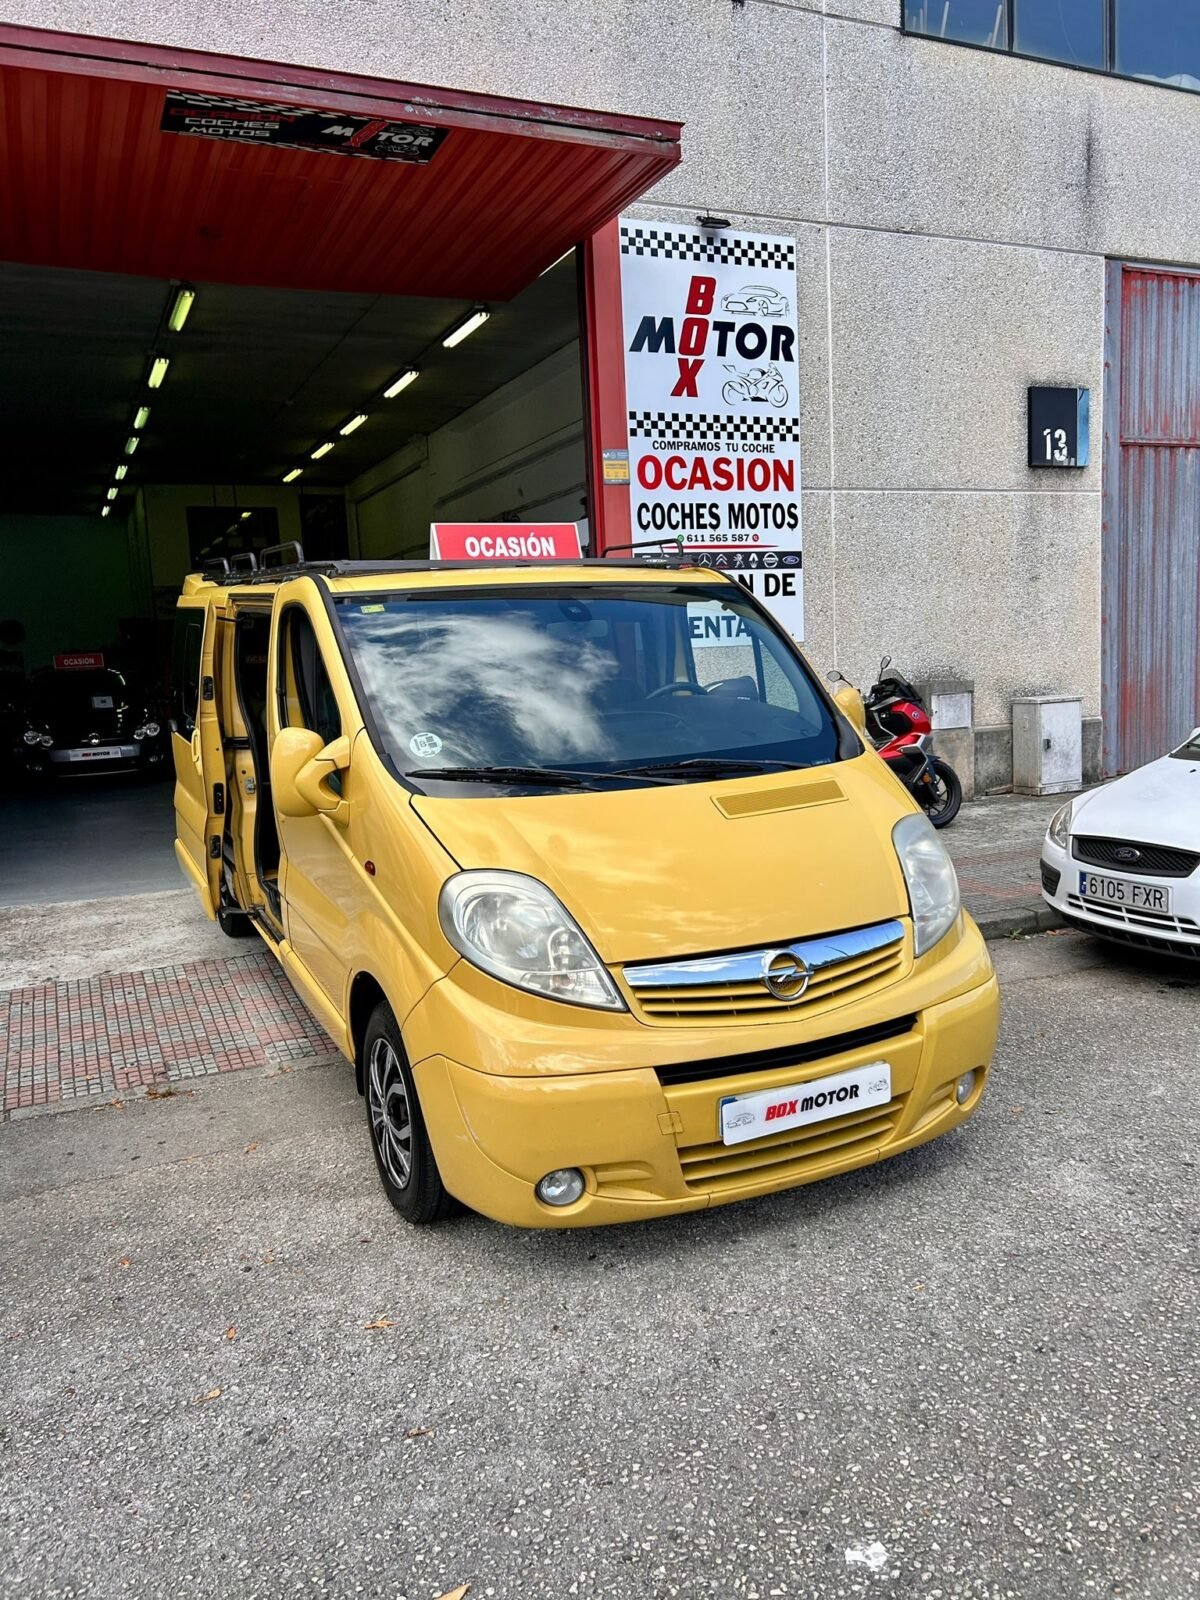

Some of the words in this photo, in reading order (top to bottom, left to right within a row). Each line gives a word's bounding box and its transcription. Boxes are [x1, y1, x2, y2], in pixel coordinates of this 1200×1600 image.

[184, 117, 281, 129] COCHES
[189, 126, 271, 137] MOTOS
[629, 316, 796, 362] MOTOR
[670, 275, 717, 398] BOX
[652, 440, 721, 452] COMPRAMOS
[725, 442, 739, 452] TU
[741, 443, 776, 454] COCHE
[1043, 428, 1068, 462] 13
[637, 454, 795, 492] OCASION
[637, 502, 720, 531] COCHES
[728, 502, 799, 530] MOTOS
[465, 532, 556, 558] OCASIÓN
[686, 533, 706, 543] 611
[709, 533, 728, 543] 565
[731, 533, 750, 543] 587
[764, 573, 796, 597] DE
[689, 615, 752, 639] ENTA
[1089, 877, 1125, 901] 6105
[1132, 886, 1164, 909] FXR
[765, 1099, 799, 1121] BOX
[800, 1084, 860, 1112] MOTOR
